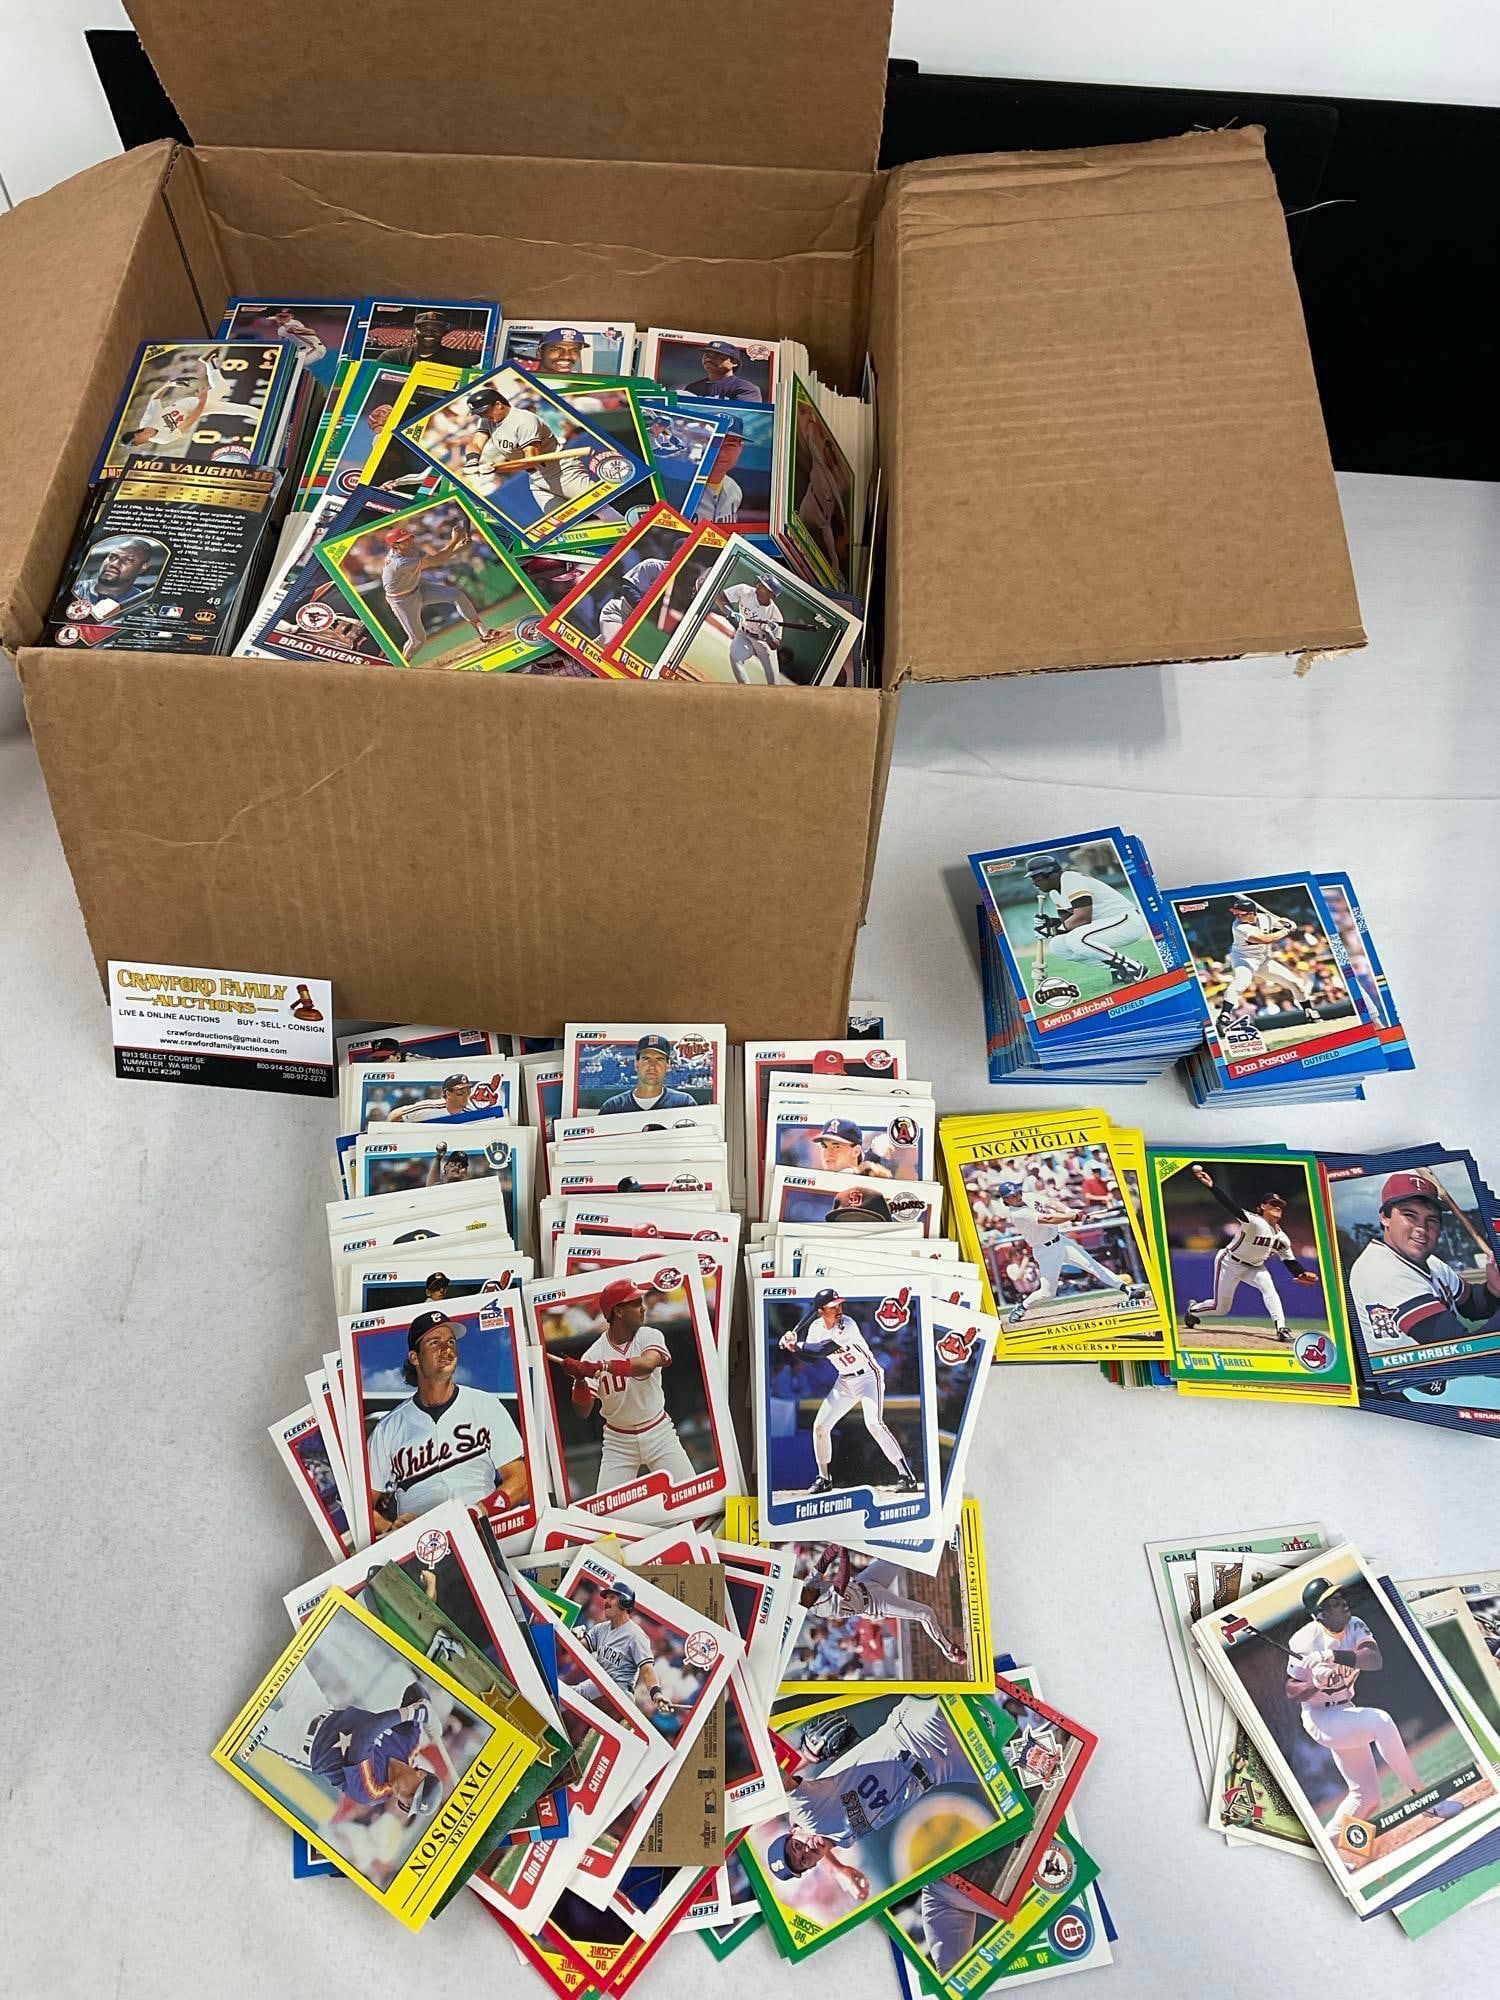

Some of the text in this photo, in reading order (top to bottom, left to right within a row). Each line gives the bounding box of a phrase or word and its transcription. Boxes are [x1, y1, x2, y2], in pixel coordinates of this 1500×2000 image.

[133, 460, 164, 470] MO
[207, 597, 221, 605] 48
[279, 637, 363, 665] BRAD HAVENS
[117, 969, 287, 1000] CRAWFORD FAMILY
[152, 995, 256, 1014] AUCTIONS
[1042, 997, 1114, 1029] Kevin Mitchell
[1110, 999, 1144, 1017] OUTFIELD
[179, 1014, 220, 1024] AUCTIONS
[261, 1021, 280, 1029] SELL
[288, 1024, 325, 1033] CONSIGN
[159, 1038, 287, 1054] www.crawfordfamilyauctions.com
[166, 1029, 279, 1045] crawfordauctions@gmail.com
[1227, 1032, 1261, 1044] SOX
[1235, 1050, 1298, 1075] Dan Pasqua
[1304, 1051, 1339, 1066] OUTFIELD
[257, 1063, 304, 1074] 800-914-SOLD
[283, 1072, 327, 1082] 360-972-2270
[1013, 1128, 1041, 1137] PETE
[973, 1131, 1089, 1158] INCAVIGLIA
[1160, 1162, 1180, 1178] SCORE
[784, 1177, 806, 1185] FLEER
[576, 1214, 600, 1222] FLEER
[344, 1241, 367, 1251] FLEER
[534, 1293, 556, 1303] FLEER
[351, 1319, 375, 1329] FLEER
[1047, 1318, 1118, 1335] RANGERS OF
[839, 1353, 856, 1367] 16
[1183, 1352, 1253, 1367] JOHN FARRELL
[1383, 1344, 1472, 1366] KENT HRBEK 1B
[602, 1375, 626, 1395] 10
[283, 1422, 306, 1439] FLEER
[392, 1434, 452, 1482] White
[587, 1484, 648, 1515] Luis Quinones
[672, 1479, 714, 1503] SECOND BASE
[797, 1497, 852, 1518] Felix Fermin
[880, 1506, 920, 1521] SHORTSTOP
[507, 1516, 525, 1530] BASE
[1282, 1539, 1312, 1551] FLEER
[584, 1559, 606, 1577] FLEER
[762, 1586, 773, 1613] FLEER
[968, 1554, 981, 1632] PHILLIES OF
[297, 1596, 321, 1615] FLEER
[603, 1646, 623, 1666] YORK
[260, 1645, 305, 1711] ASTROS OF
[248, 1726, 268, 1753] FLEER
[967, 1728, 997, 1781] SCHOOLER
[588, 1756, 610, 1793] CATCHER
[741, 1780, 766, 1797] FLEER
[858, 1774, 889, 1810] 40
[1380, 1808, 1403, 1829] JERRY
[1403, 1790, 1440, 1814] BROWNE
[409, 1761, 492, 1878] DAVIDSON
[449, 1812, 476, 1846] MARK
[523, 1864, 538, 1886] Don
[692, 1904, 719, 1916] FLEER
[790, 1915, 823, 1934] SCORE
[587, 1946, 620, 1958] SCORE
[950, 1896, 1049, 1992] LARRY SHEETS DH
[1037, 1952, 1048, 1964] OF
